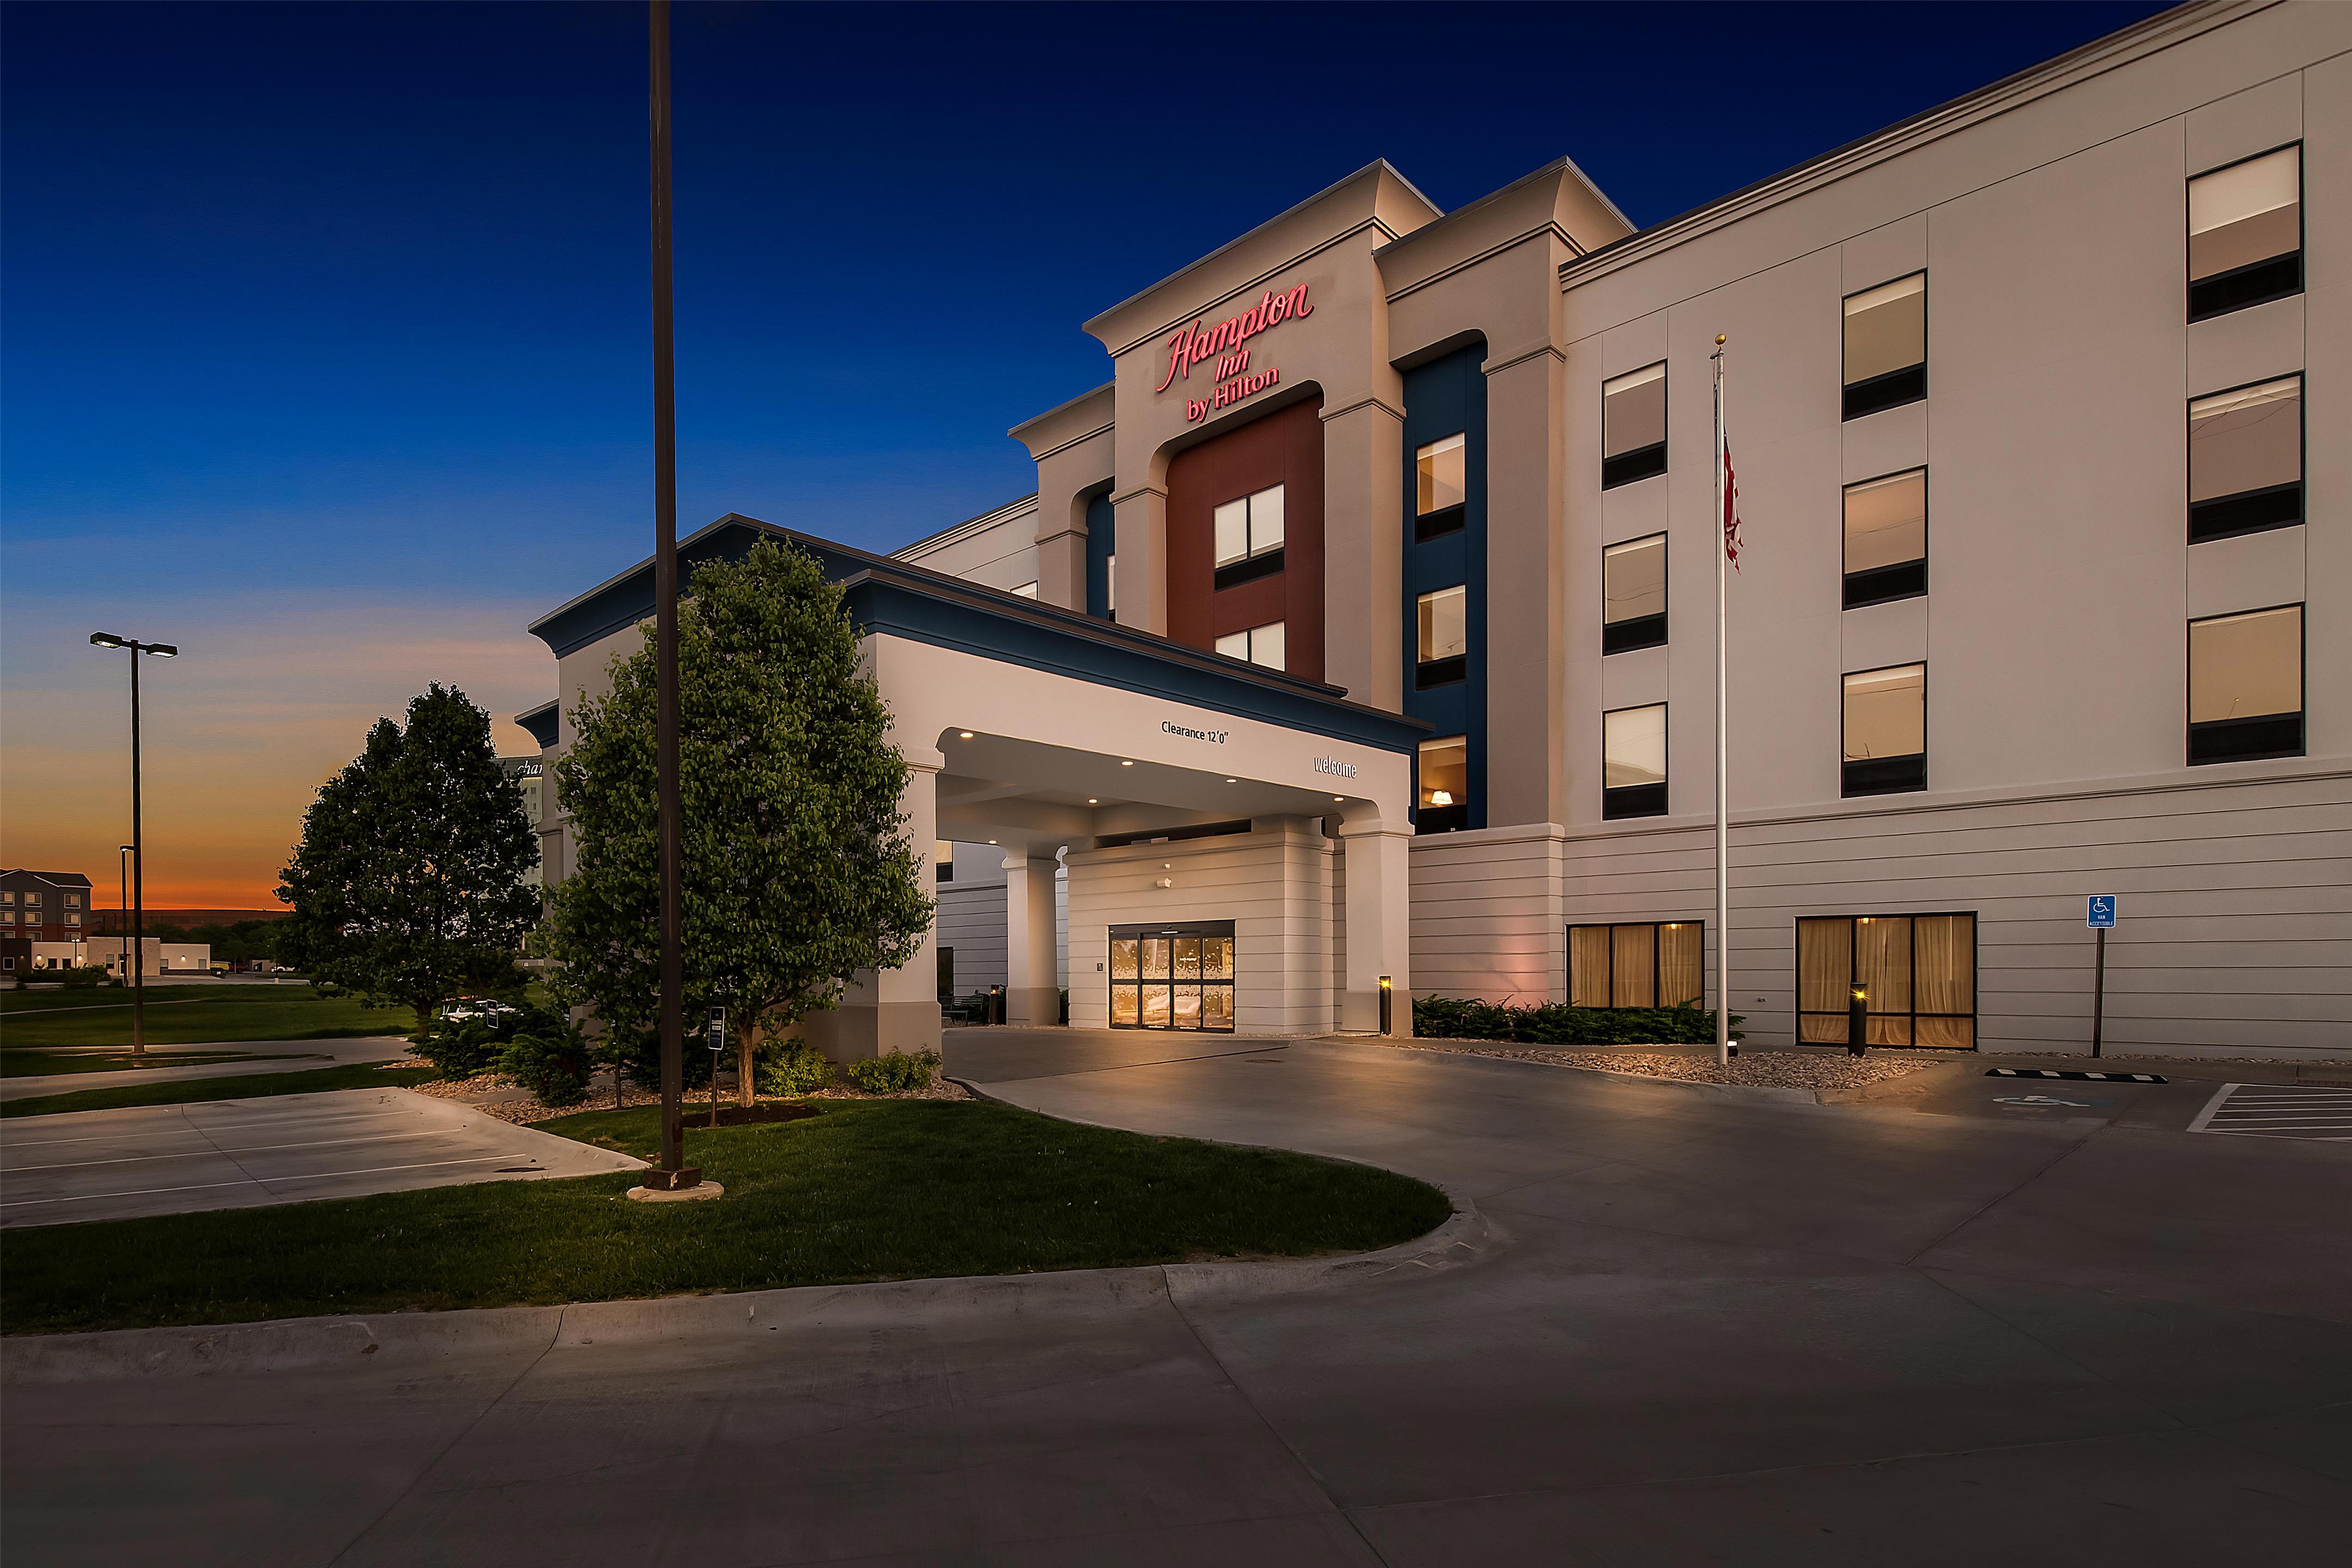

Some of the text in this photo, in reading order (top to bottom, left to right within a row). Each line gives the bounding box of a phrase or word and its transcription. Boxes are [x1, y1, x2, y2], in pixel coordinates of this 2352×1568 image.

[1155, 283, 1315, 393] Hampton
[1215, 349, 1250, 383] Inn
[1187, 367, 1280, 422] by Hilton
[1161, 720, 1205, 740] Clearance
[1313, 755, 1357, 779] welcome
